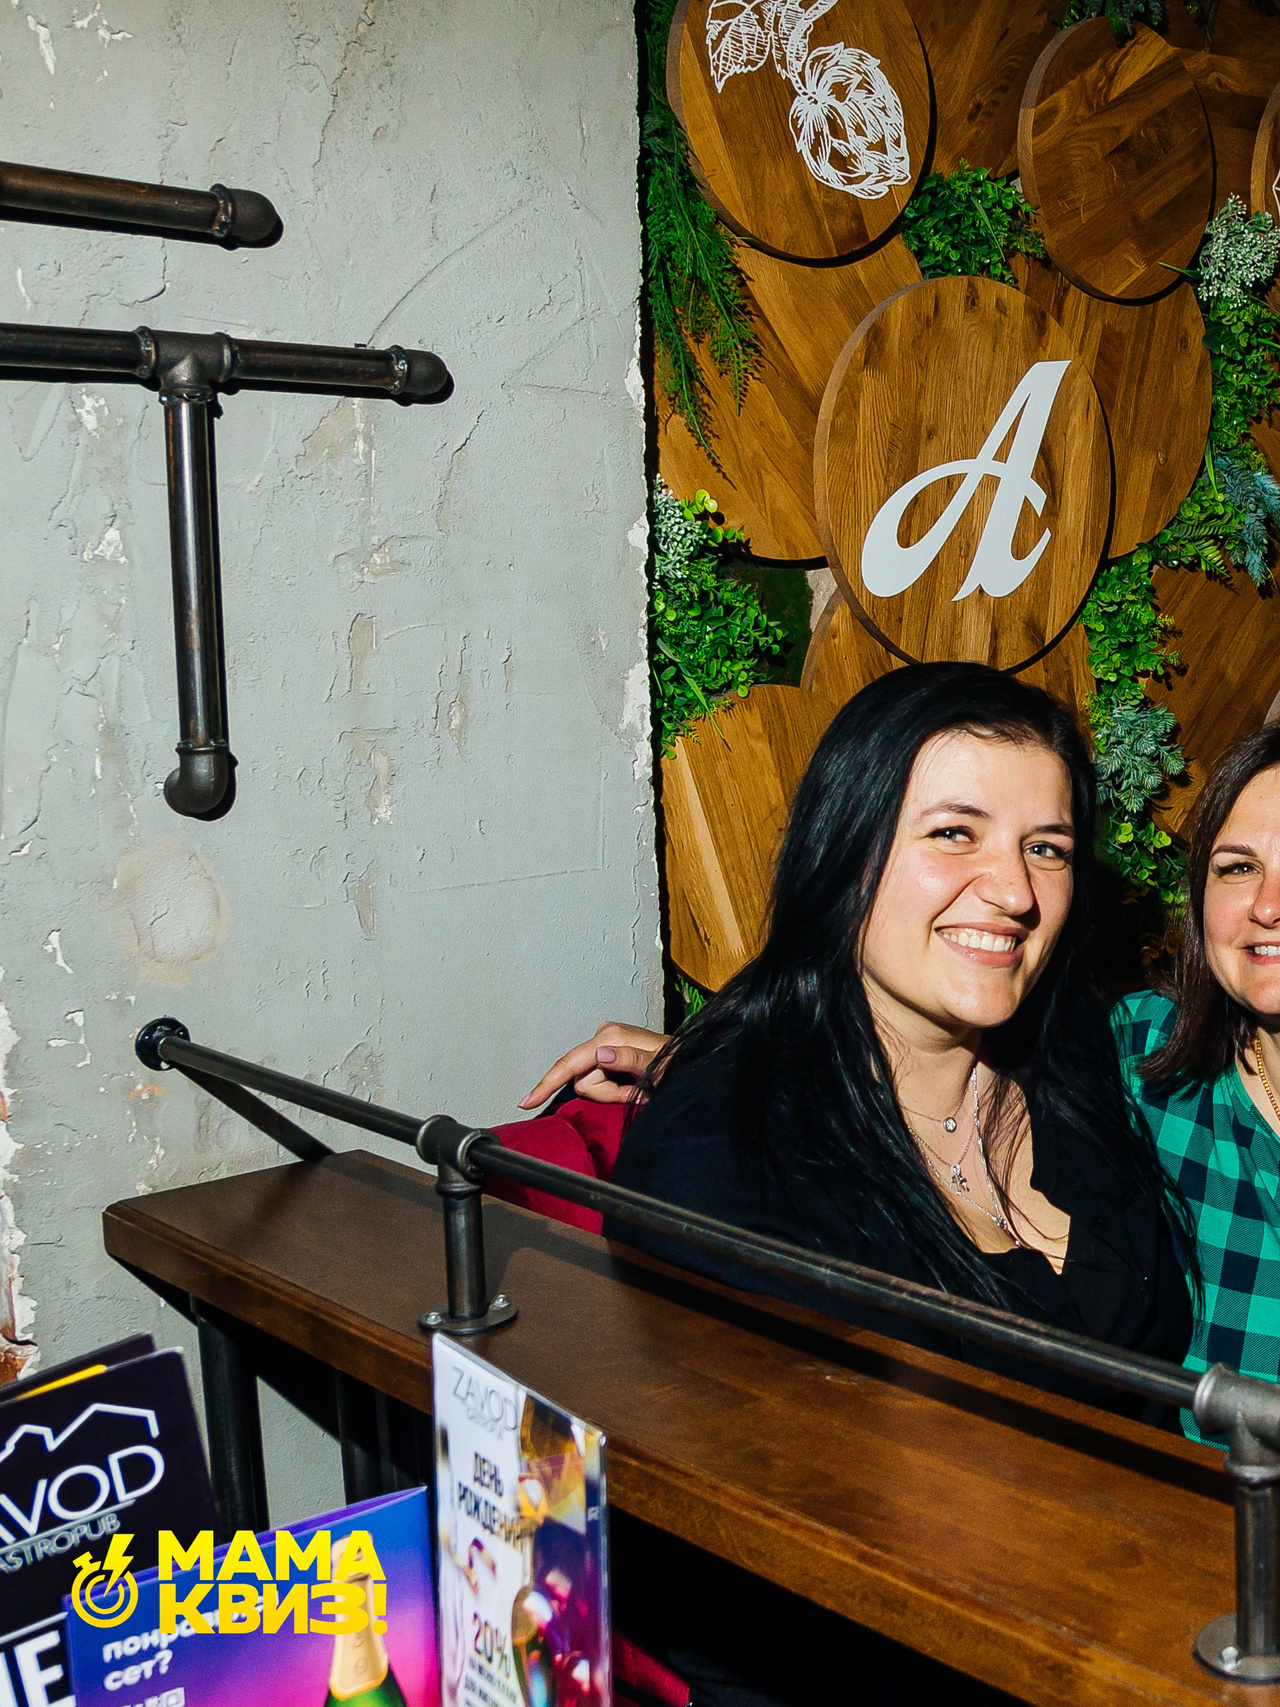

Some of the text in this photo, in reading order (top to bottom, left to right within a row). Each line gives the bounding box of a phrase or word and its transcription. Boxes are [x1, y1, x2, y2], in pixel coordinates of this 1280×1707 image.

[452, 1366, 518, 1431] ZAVOD
[103, 1649, 173, 1691] сет?
[473, 1611, 512, 1679] 20%
